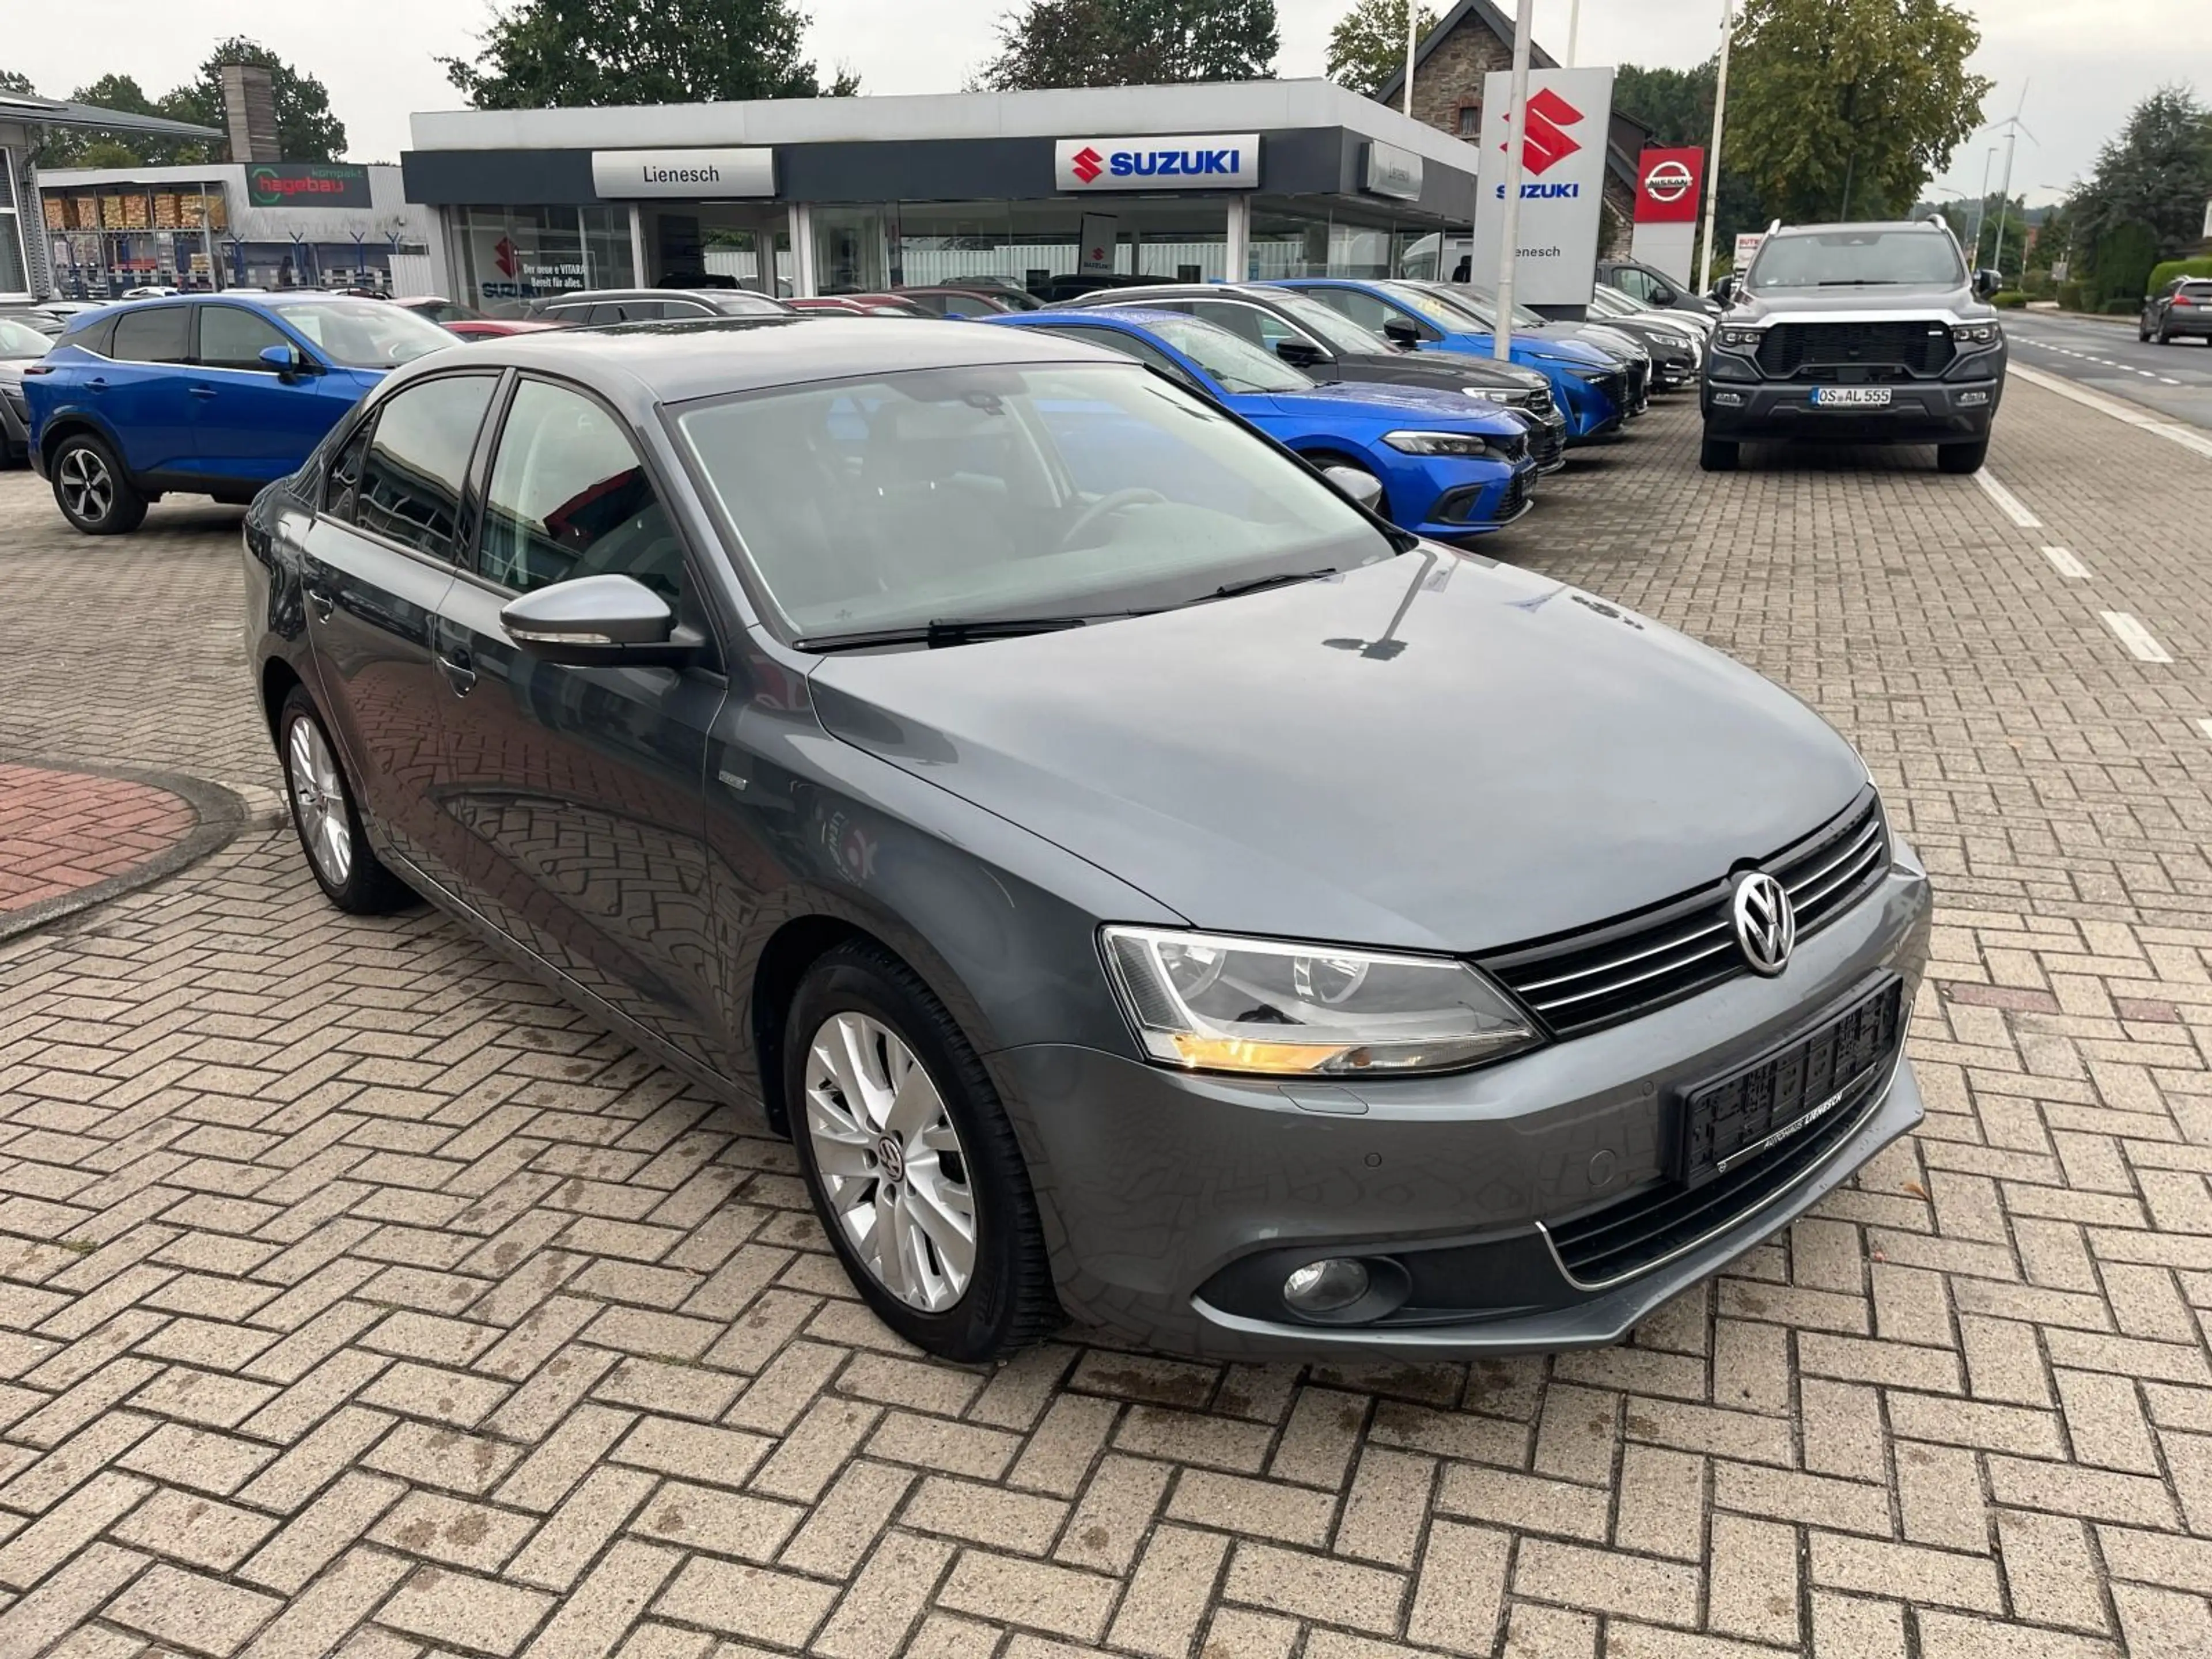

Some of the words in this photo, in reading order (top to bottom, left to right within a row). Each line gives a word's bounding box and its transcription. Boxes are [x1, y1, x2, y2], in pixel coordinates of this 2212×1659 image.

[1110, 150, 1239, 176] SUZUKI
[312, 168, 365, 179] kompakt
[643, 165, 719, 182] Lienesch
[260, 175, 344, 195] hagebau
[1648, 179, 1687, 187] NISSAN
[1496, 184, 1578, 199] SZUKI
[1516, 246, 1560, 257] enesch
[560, 264, 586, 274] VITARA
[1819, 390, 1836, 402] OS
[1844, 390, 1862, 402] AL
[1865, 390, 1889, 402] 555
